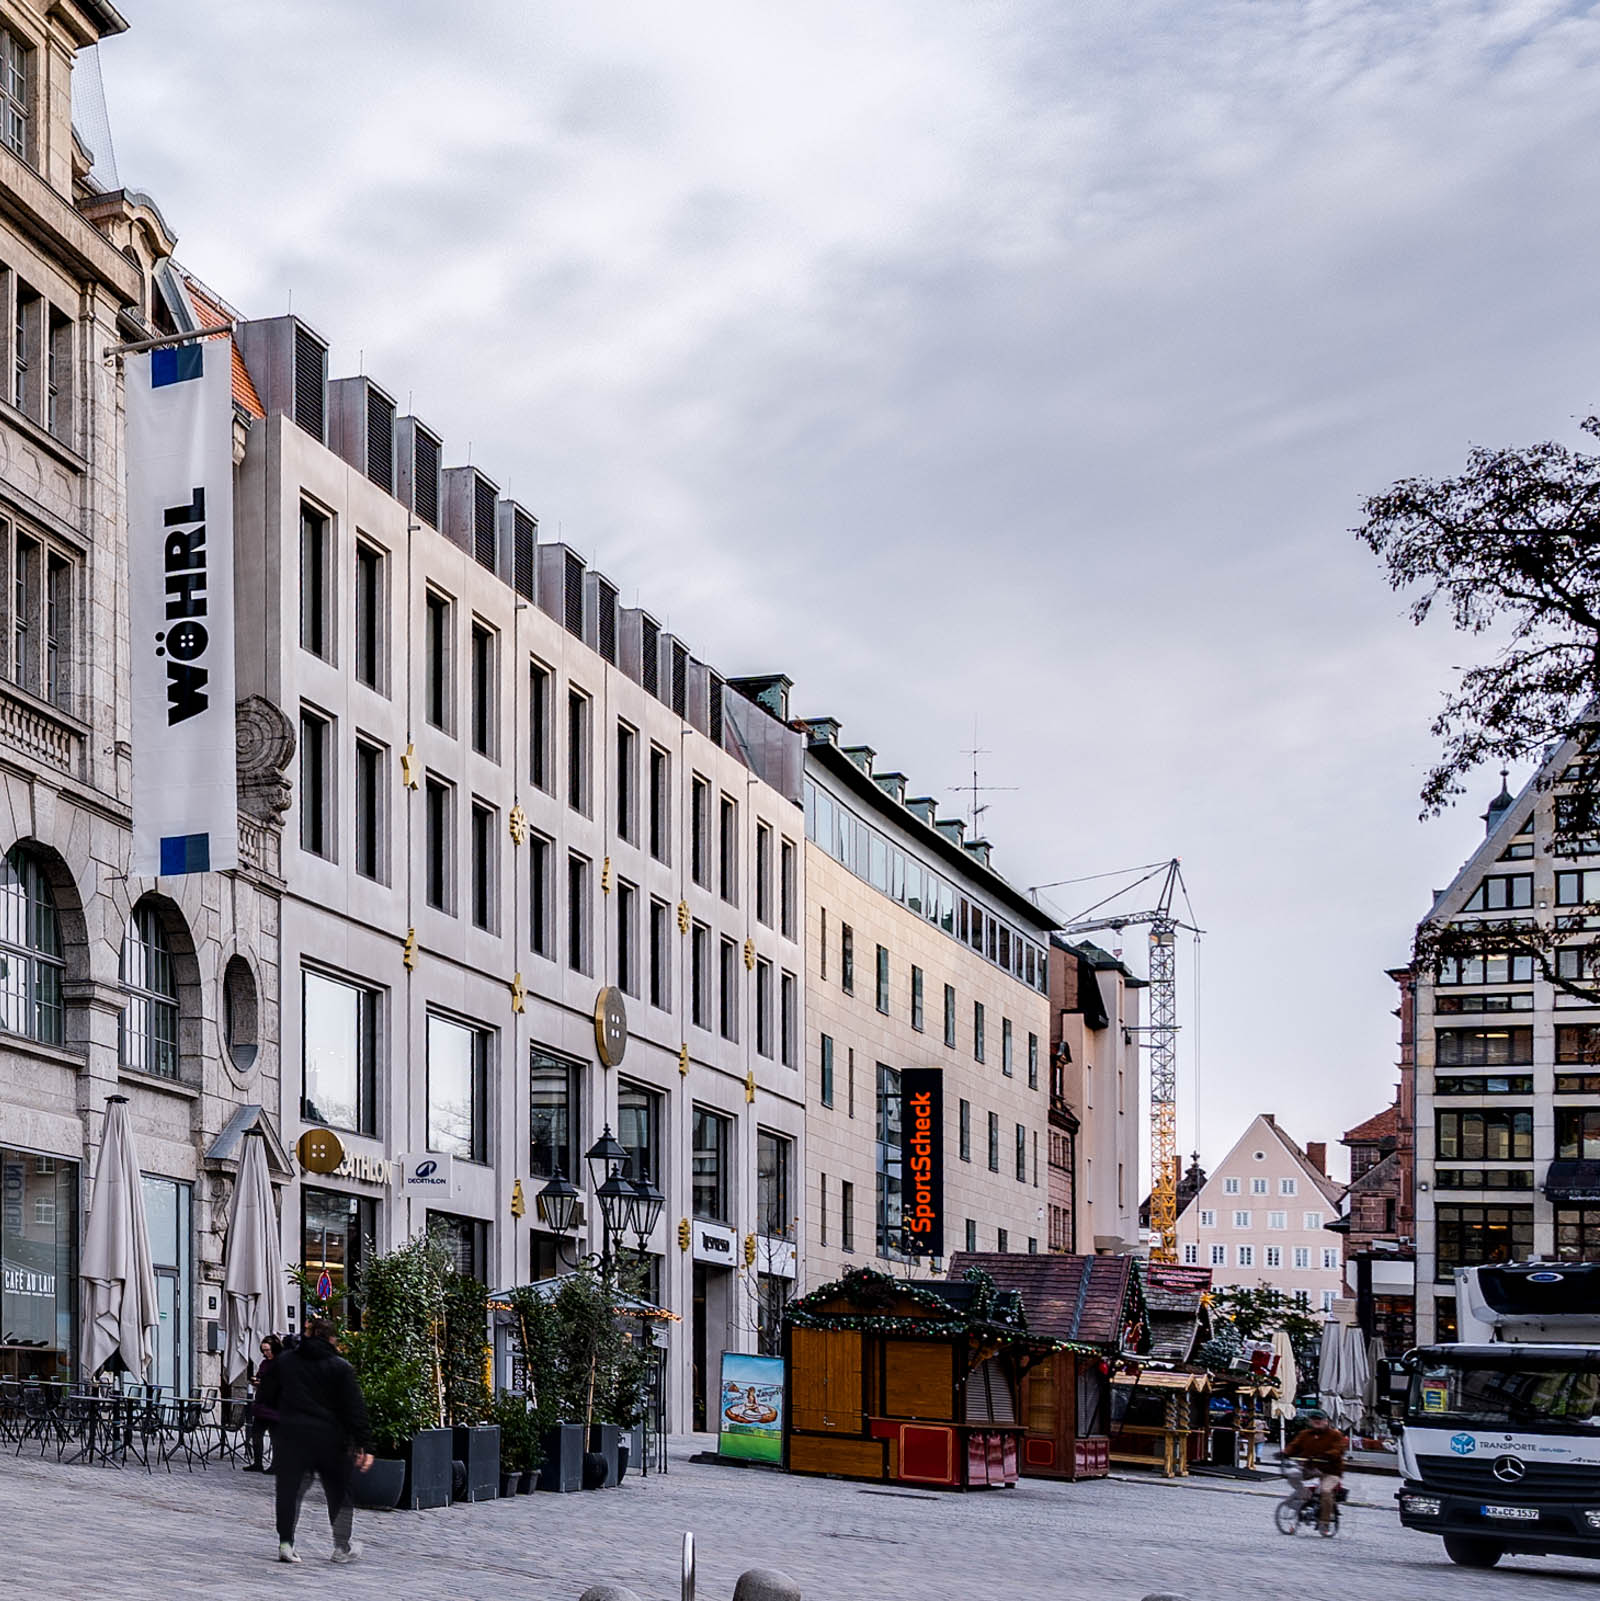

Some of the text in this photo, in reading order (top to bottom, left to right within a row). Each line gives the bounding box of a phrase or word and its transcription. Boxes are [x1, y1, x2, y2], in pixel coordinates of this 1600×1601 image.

[155, 486, 209, 727] WÖHRL
[333, 1151, 393, 1186] CATHLON
[910, 1091, 935, 1233] SportScheck
[407, 1177, 447, 1185] DECATHLON
[5, 1268, 55, 1293] CAFÉ AU LAIT
[1479, 1441, 1537, 1451] TRANSPORTE
